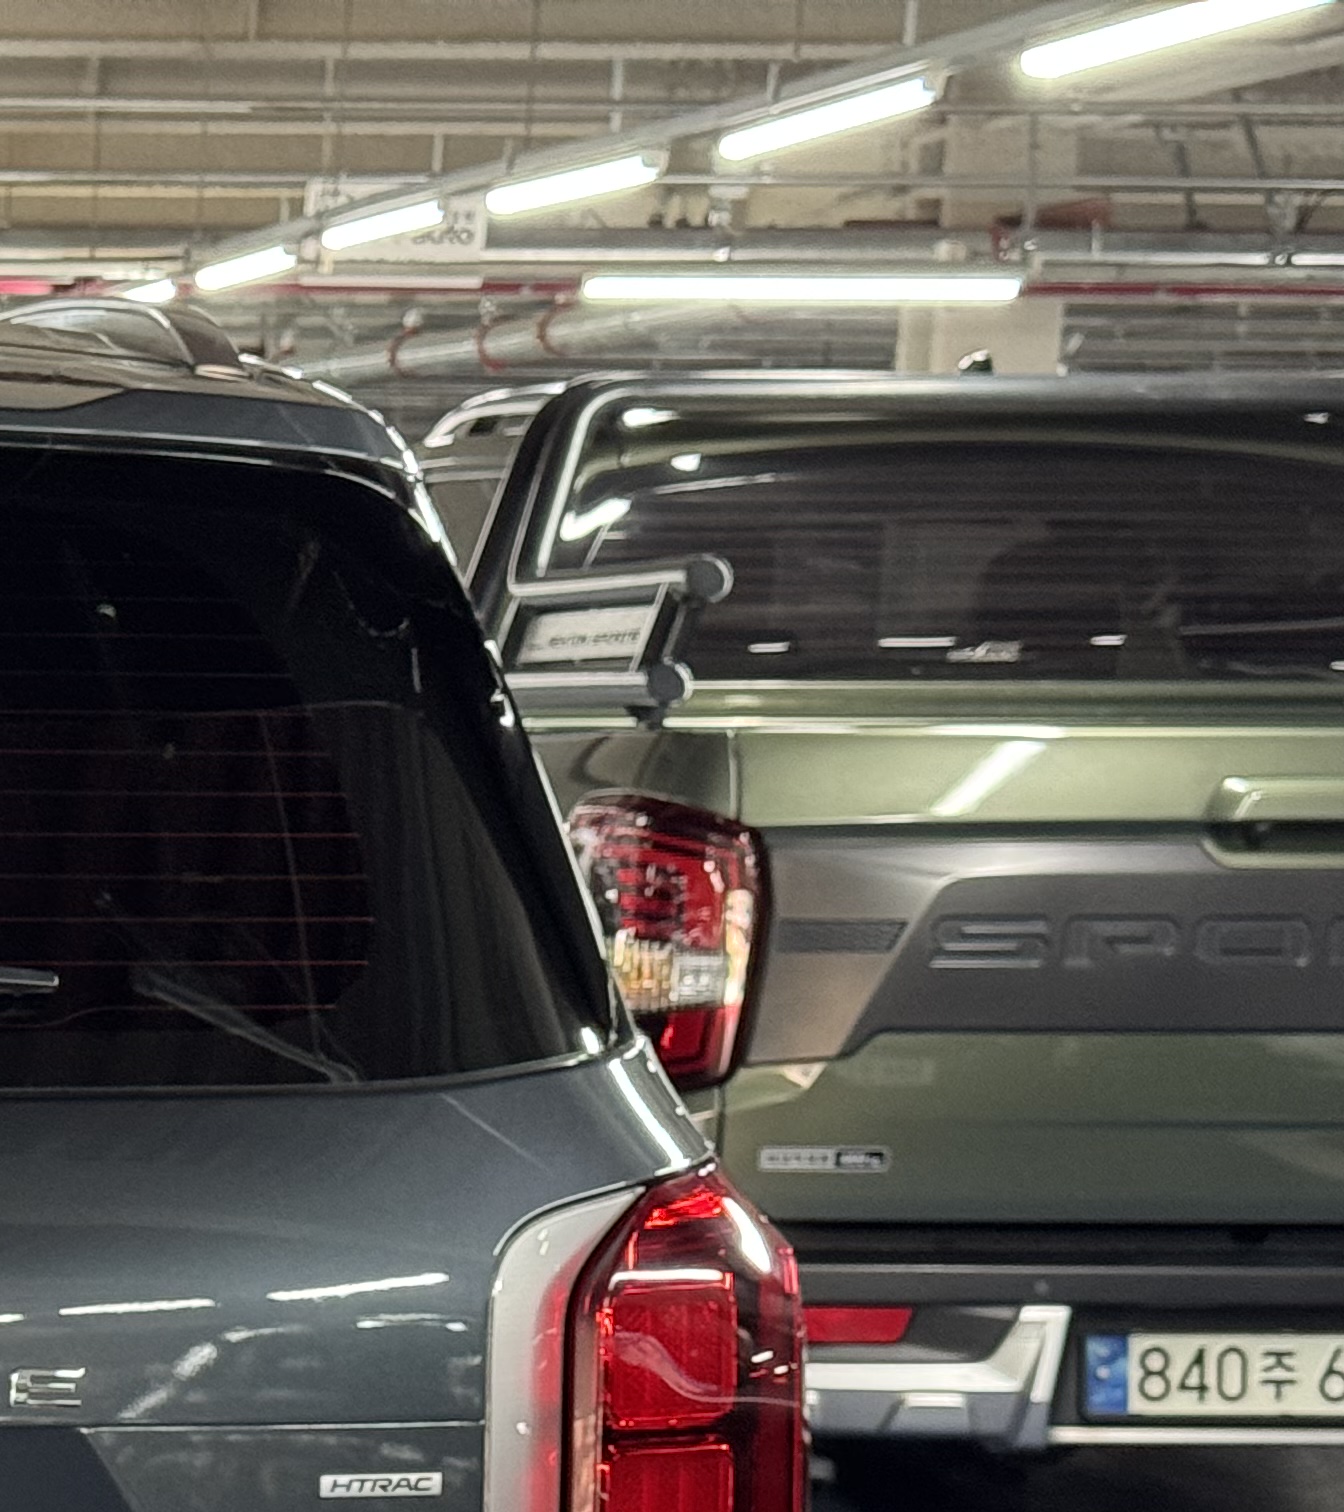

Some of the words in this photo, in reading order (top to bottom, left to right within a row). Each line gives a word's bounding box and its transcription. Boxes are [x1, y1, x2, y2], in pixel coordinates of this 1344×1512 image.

[928, 912, 1344, 970] SPO
[1137, 1346, 1298, 1403] 840주
[329, 1476, 434, 1494] HTRAC
